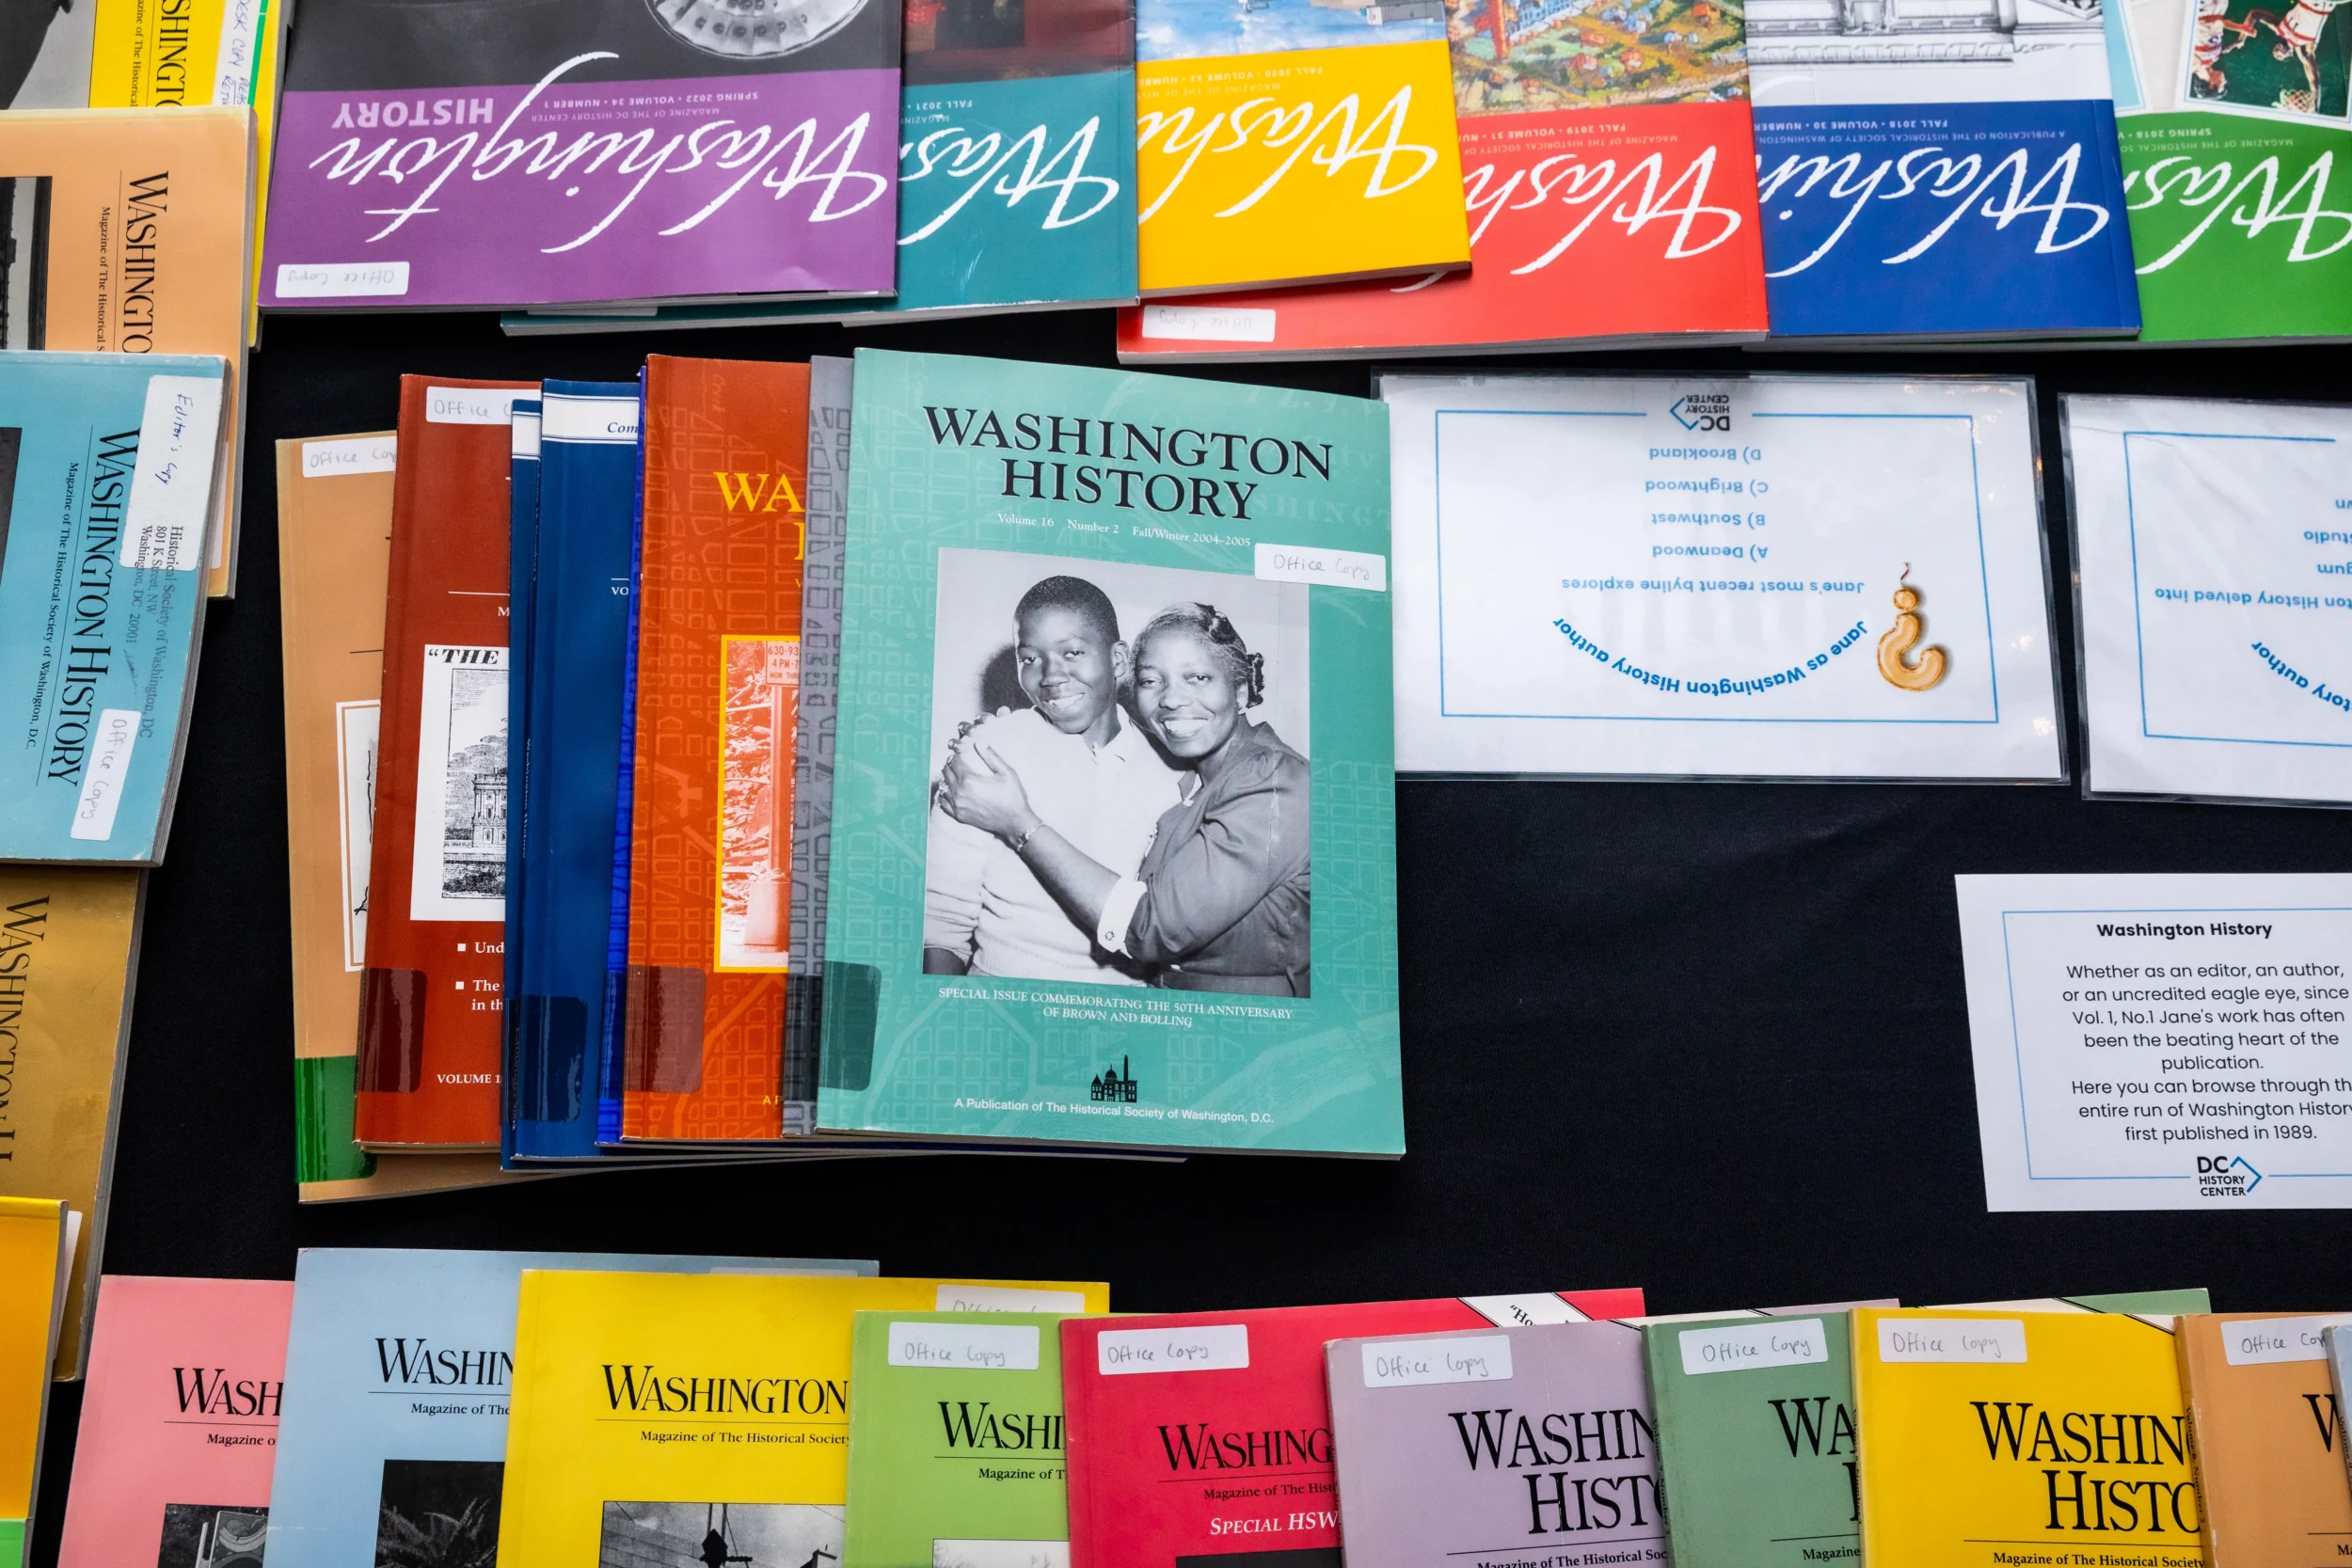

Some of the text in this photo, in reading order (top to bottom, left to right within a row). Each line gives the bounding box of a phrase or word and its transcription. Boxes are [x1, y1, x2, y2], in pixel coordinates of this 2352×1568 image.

[544, 91, 758, 109] SPRING 2022 VOLUME 34 NUMBER 1
[331, 97, 494, 129] HISTORY
[1491, 123, 1627, 140] FALL 2019 VOLUME 31
[1753, 119, 1948, 132] FALL 2018 VOLUME 30 NUMBER
[310, 50, 887, 254] Washington
[97, 207, 111, 343] Magazine of The Historical
[1685, 404, 1730, 414] HISTORY
[1686, 394, 1730, 404] CENTER
[1700, 415, 1731, 432] DC
[922, 405, 1334, 482] WASHINGTON
[1649, 446, 1762, 465] D) Brookland
[1000, 458, 1259, 520] HISTORY
[1645, 477, 1770, 498] C) Brightwood
[996, 513, 1038, 526] Volume
[1041, 516, 1055, 527] 16
[1067, 518, 1110, 532] Number
[1112, 524, 1120, 534] 2
[1132, 526, 1190, 542] Fall/Winter
[1651, 512, 1766, 531] B) Southwest
[1652, 544, 1769, 563] A) Deanwood
[146, 525, 168, 613] 801 K Street, NW
[125, 526, 152, 643] Washington, DC 20001
[1561, 576, 1865, 595] Jane's most recent byline explores
[25, 462, 79, 751] Magazine of The Historical Society of Washington, D.C.
[43, 427, 142, 787] WASHINGTON HISTORY
[2154, 588, 2319, 610] History delved into
[138, 526, 183, 738] Historical Society of Washington, DC
[1552, 618, 1867, 697] Jane as Washington History author
[2250, 641, 2309, 689] author
[2096, 921, 2273, 941] Washington History
[2066, 962, 2344, 979] Whether as an editor, an author,
[939, 988, 1293, 1020] SPECIAL ISSUE COMMEMORATING THE 50TH ANNIVERSARY
[2062, 985, 2349, 1005] or an uncredited eagle eye, since
[1042, 1006, 1193, 1029] OF BROWN AND BOLLING
[2072, 1010, 2104, 1025] Vol.
[2159, 1008, 2214, 1024] Jane's
[2217, 1008, 2260, 1023] work
[2263, 1008, 2296, 1023] has
[2299, 1007, 2345, 1022] often
[2084, 1031, 2340, 1051] been the beating heart of the
[2161, 1054, 2264, 1074] publication.
[437, 1073, 492, 1085] VOLUME
[2072, 1077, 2330, 1099] Here you can browse through
[953, 1098, 1275, 1124] A Publication of The Historical Society of Washington, D.C.
[2078, 1102, 2129, 1118] entire
[2134, 1105, 2163, 1117] run
[2167, 1101, 2185, 1117] of
[2187, 1101, 2295, 1121] Washington
[2124, 1124, 2317, 1145] first published in 1989.
[2197, 1155, 2230, 1174] DC
[2199, 1175, 2246, 1185] HISTORY
[2200, 1186, 2247, 1197] CENTER
[601, 1364, 850, 1415] WASHINGTON
[641, 1431, 698, 1444] Magazine
[701, 1432, 715, 1442] of
[721, 1432, 743, 1443] The
[746, 1433, 805, 1444] Historical
[1210, 1517, 1282, 1535] SPECIAL
[1993, 1552, 2158, 1568] Magazine of The Historical
